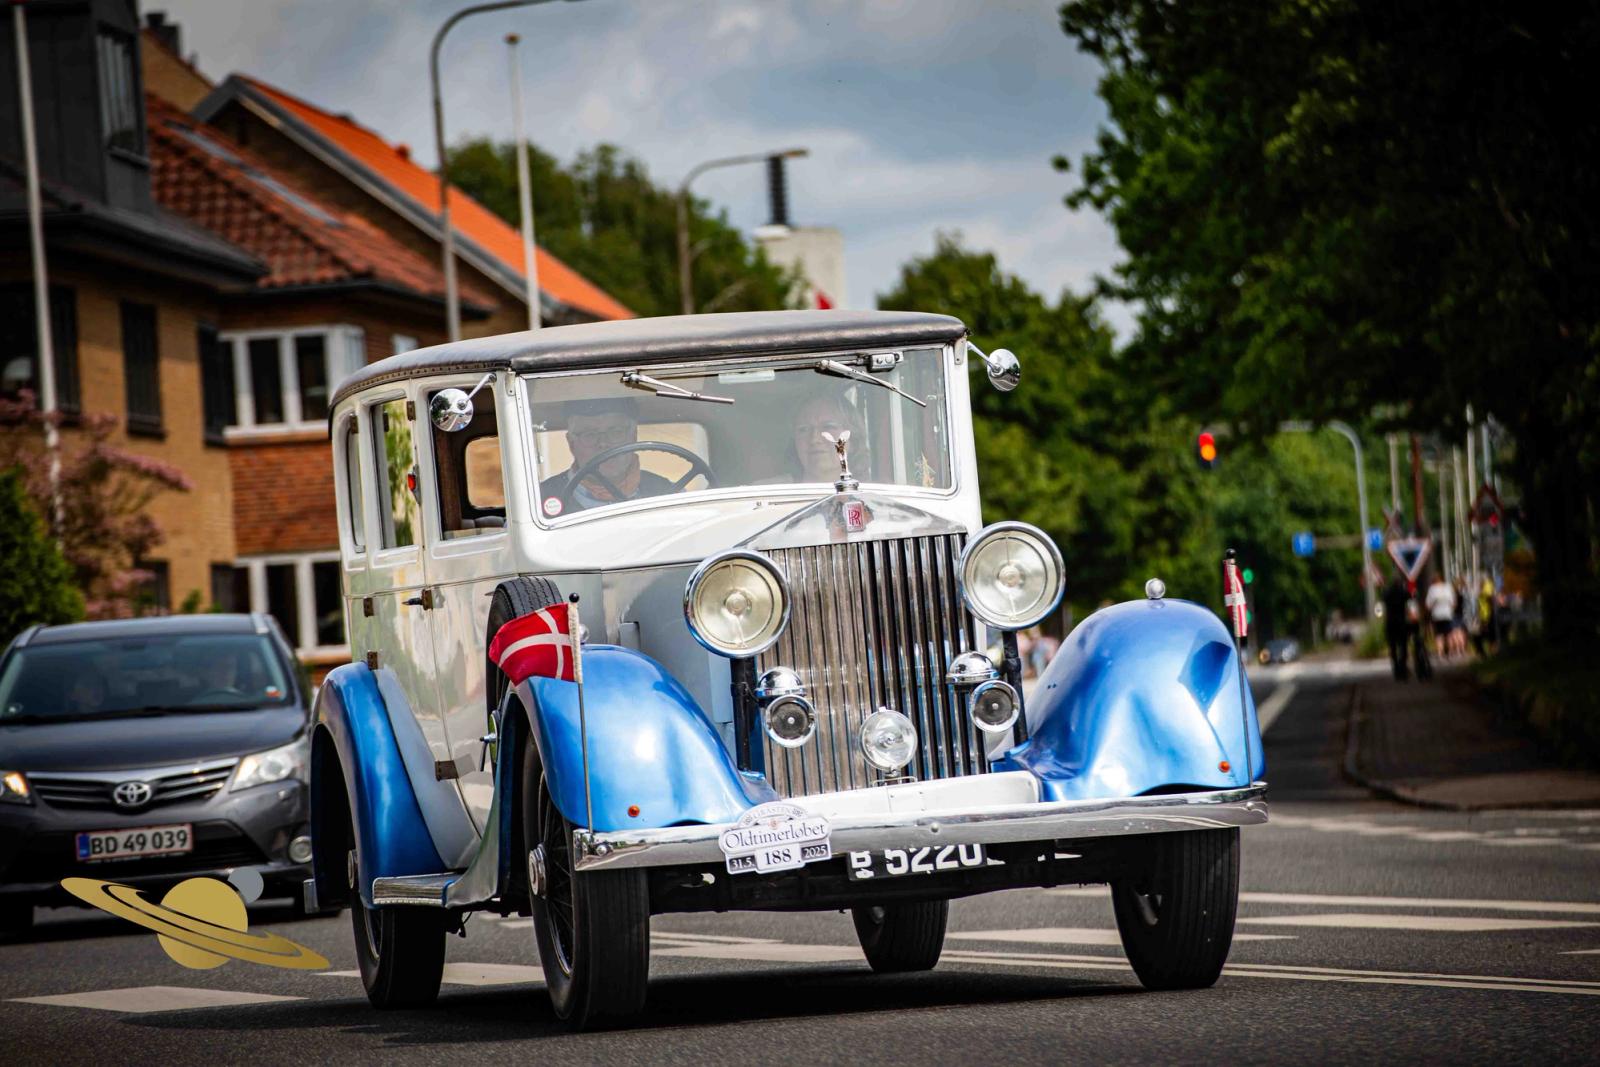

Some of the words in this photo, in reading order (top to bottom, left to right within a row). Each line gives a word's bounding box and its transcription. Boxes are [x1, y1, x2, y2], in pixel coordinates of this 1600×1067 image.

[91, 836, 118, 854] BD
[123, 833, 147, 851] 49
[151, 829, 188, 849] 039
[765, 848, 792, 865] 188
[803, 845, 827, 858] 2025
